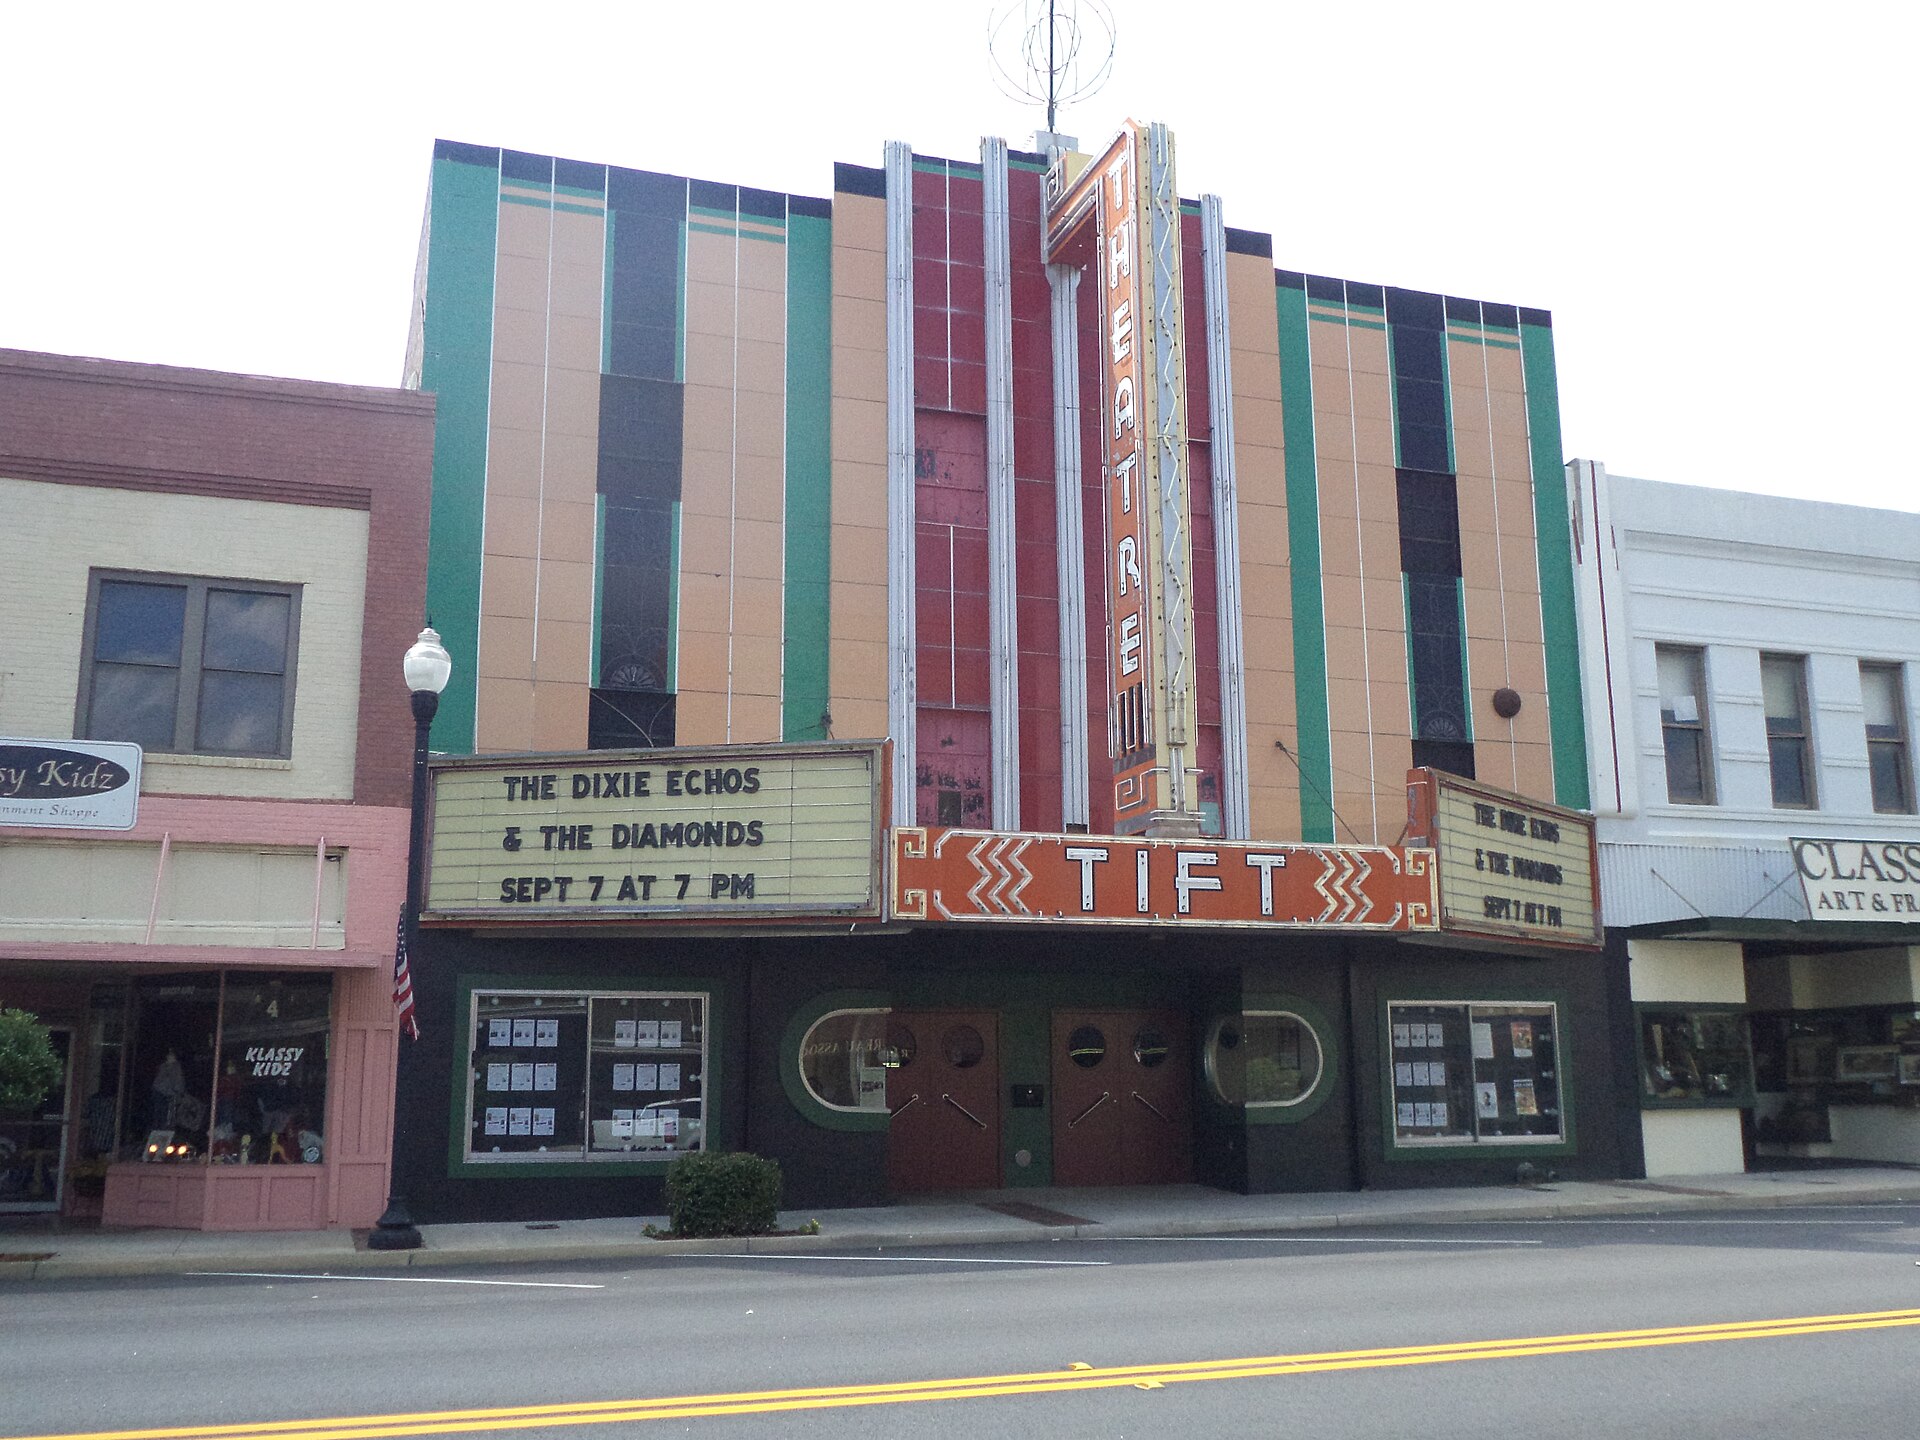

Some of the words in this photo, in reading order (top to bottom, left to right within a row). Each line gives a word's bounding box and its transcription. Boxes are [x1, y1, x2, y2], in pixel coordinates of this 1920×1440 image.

[1108, 150, 1141, 677] THEATRE
[37, 760, 114, 789] Kidz
[503, 774, 557, 801] THE
[572, 771, 651, 799] DIXIE
[666, 767, 761, 797] ECHOS
[49, 804, 98, 820] Shoppe
[502, 826, 521, 852] &
[540, 824, 593, 851] THE
[611, 820, 764, 850] DIAMONDS
[1795, 841, 1920, 884] CLASS
[499, 876, 573, 903] SEPT
[588, 875, 604, 901] 7
[616, 873, 657, 901] AT
[674, 873, 691, 900] 7
[710, 872, 755, 900] PM
[1066, 847, 1287, 916] TIFT
[1818, 890, 1865, 911] ART
[1872, 893, 1888, 912] &
[245, 1047, 304, 1062] KLASSY
[252, 1062, 292, 1077] KIDZ
